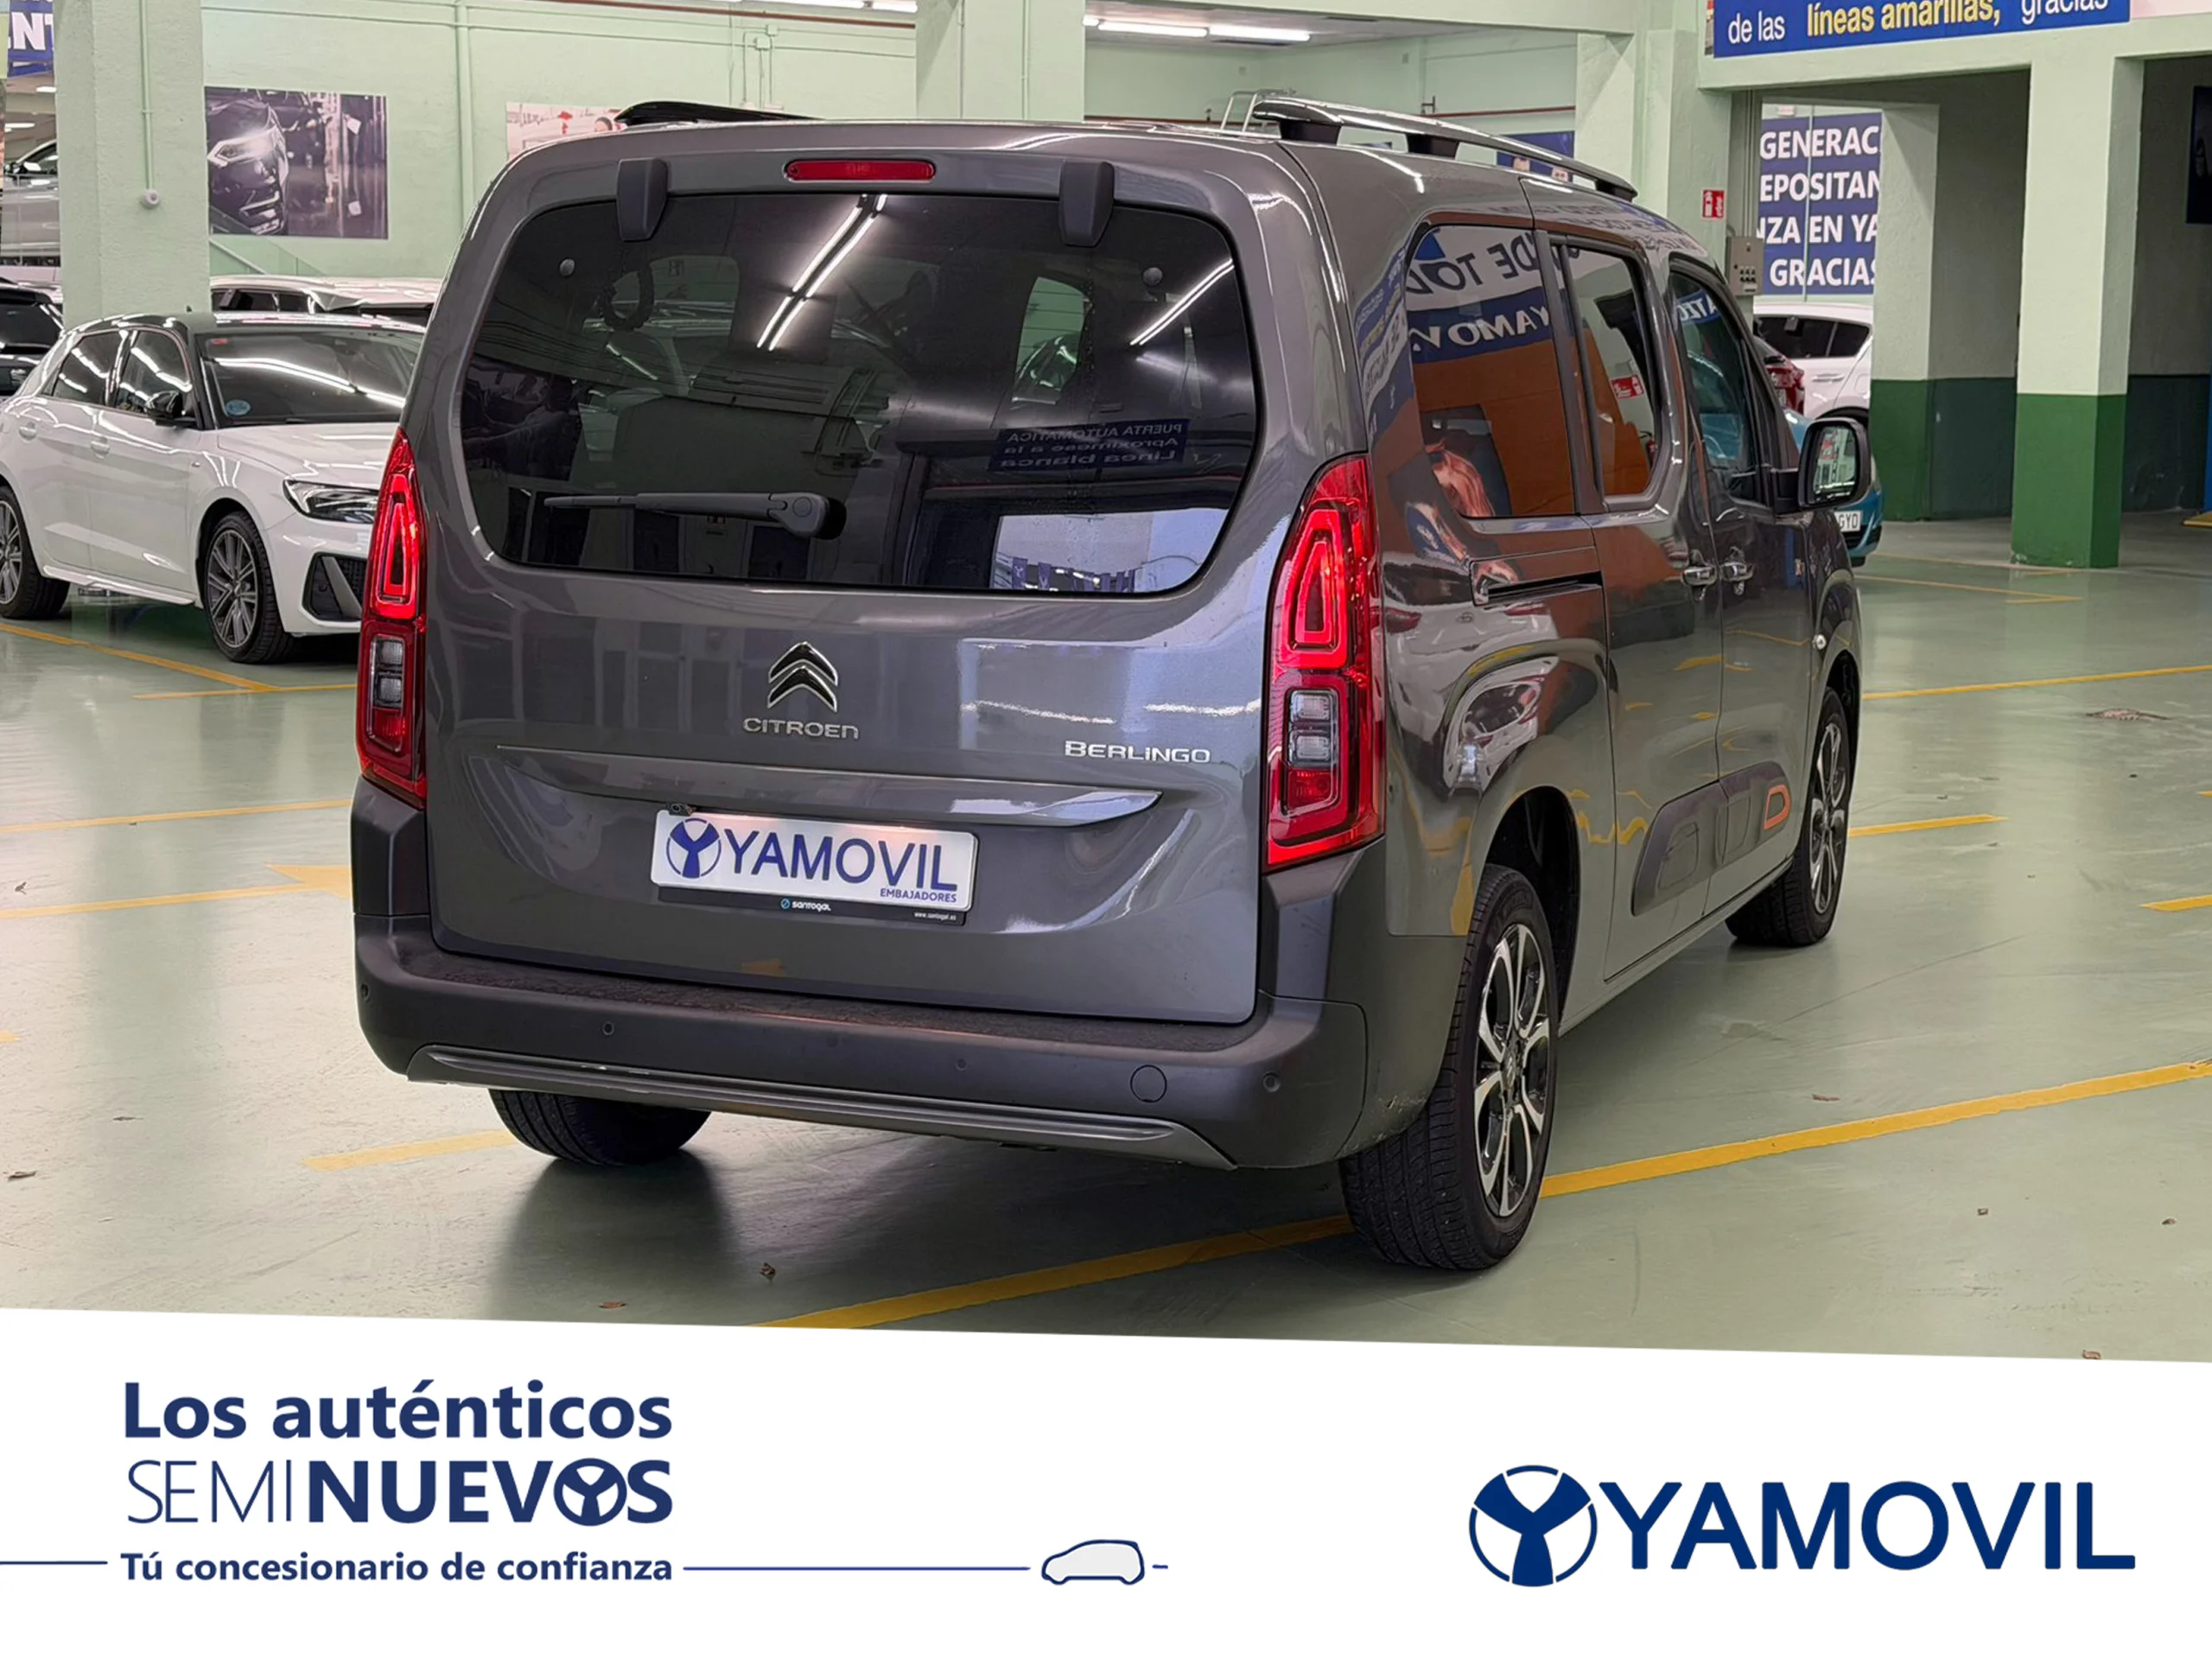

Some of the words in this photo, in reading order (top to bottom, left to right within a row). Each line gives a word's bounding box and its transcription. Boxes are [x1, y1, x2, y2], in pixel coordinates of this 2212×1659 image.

[1728, 13, 1753, 43] de
[1758, 10, 1786, 41] las
[1807, 3, 1875, 37] líneas
[1880, 0, 2001, 27] amarillas,
[1759, 125, 1882, 159] GENERAC
[1808, 215, 1843, 244] EN
[1770, 257, 1875, 287] GRACIA
[724, 829, 958, 893] YAMOVIL
[880, 888, 957, 903] EMBAJADORES
